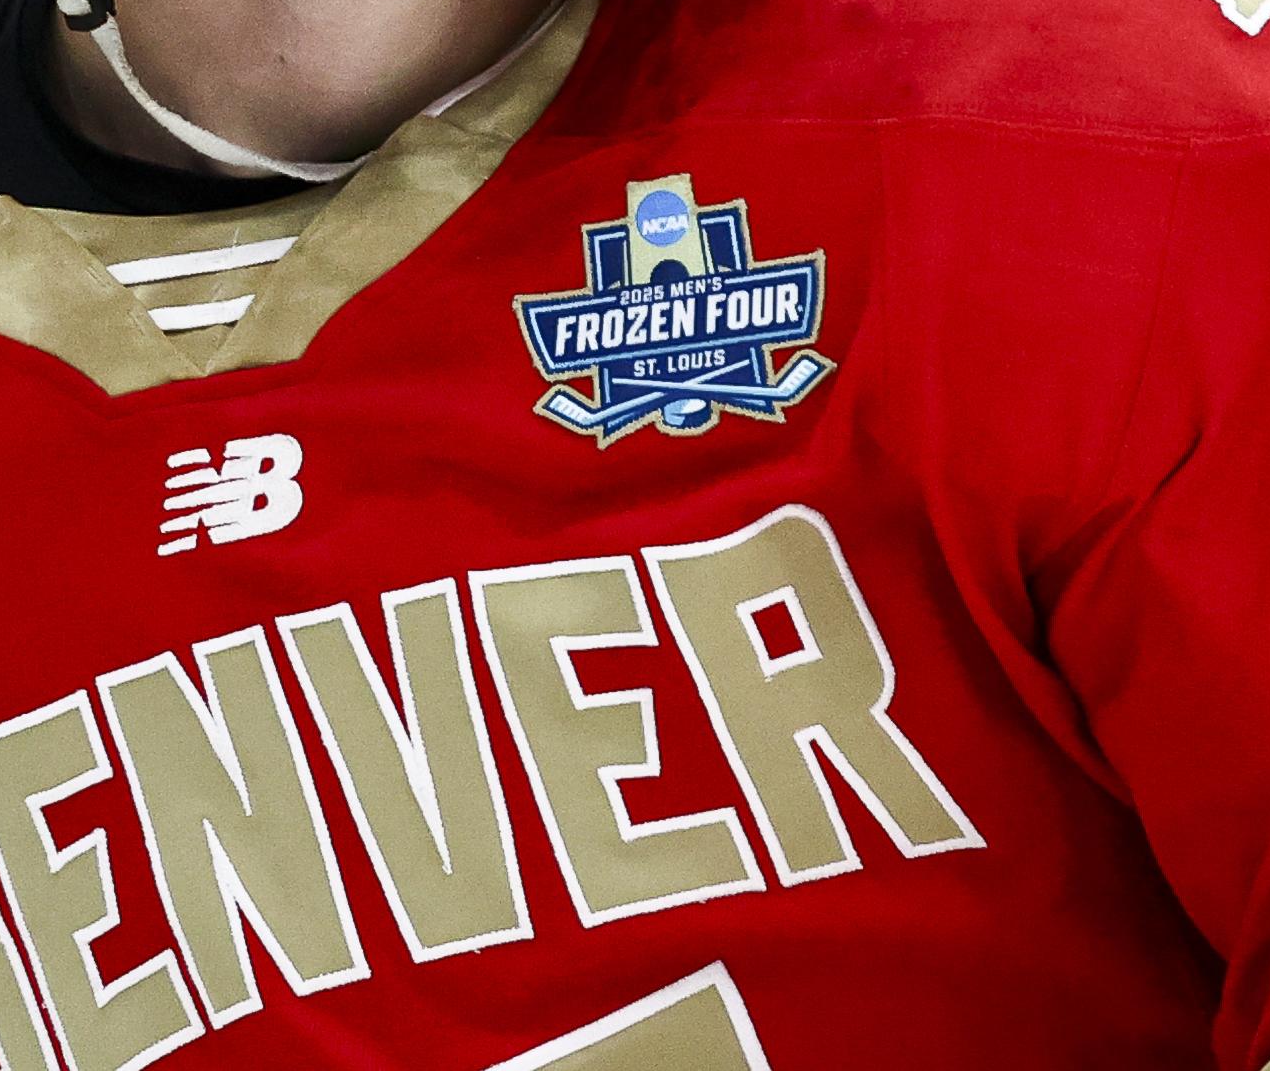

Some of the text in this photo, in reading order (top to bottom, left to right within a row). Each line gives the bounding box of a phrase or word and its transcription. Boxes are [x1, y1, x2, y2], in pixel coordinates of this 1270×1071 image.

[641, 213, 689, 236] NCAA
[620, 277, 723, 306] 2025 MEN'S
[554, 282, 801, 357] FROZEN FOUR
[633, 349, 727, 378] ST. LOUIS
